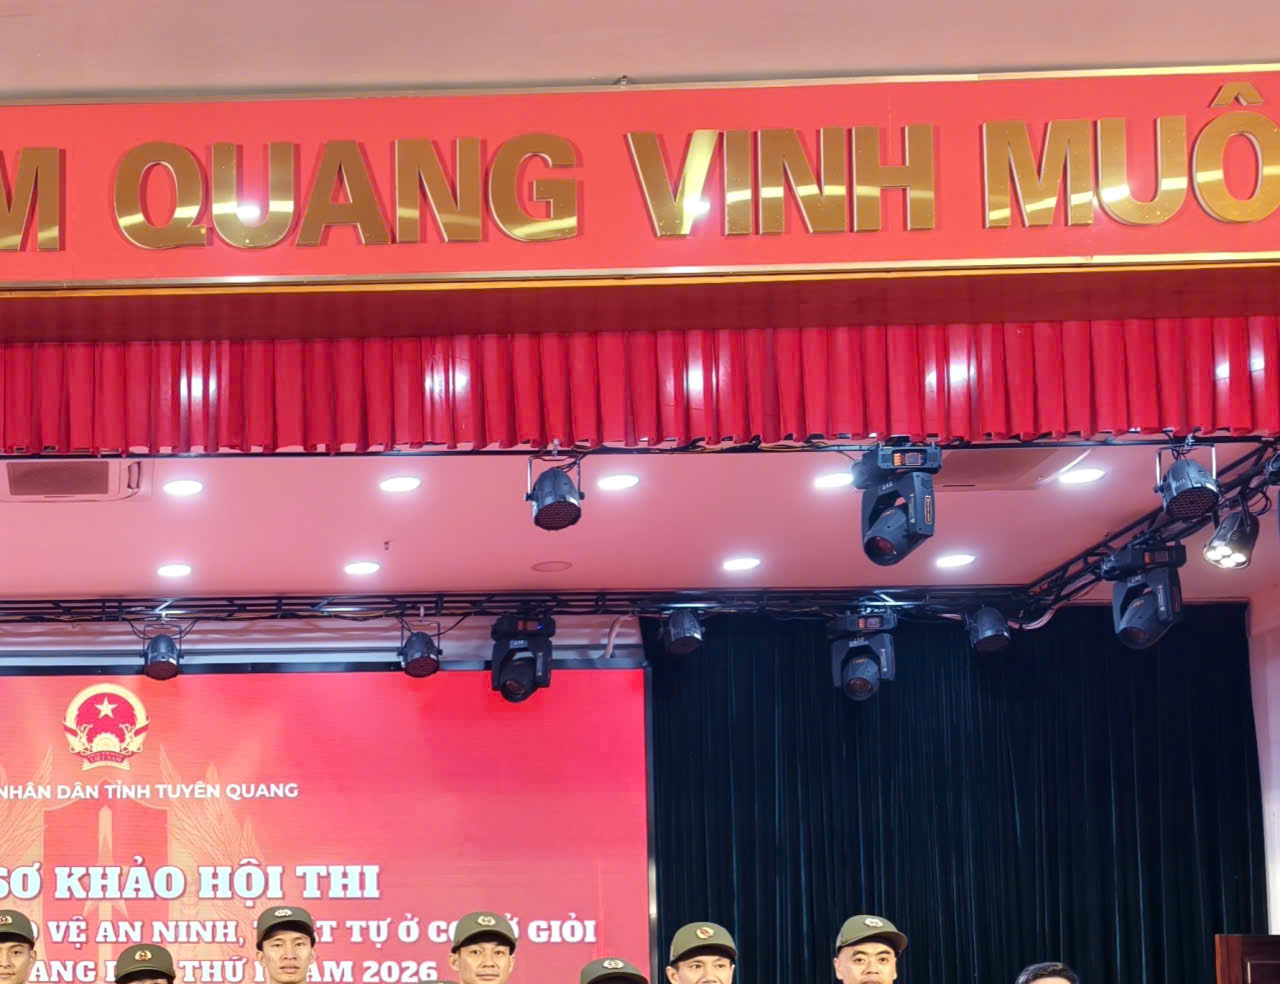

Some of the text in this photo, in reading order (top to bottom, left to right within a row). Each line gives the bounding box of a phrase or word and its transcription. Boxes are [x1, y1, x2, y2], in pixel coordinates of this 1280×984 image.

[114, 132, 580, 250] QUANG
[627, 124, 936, 237] VINH
[57, 781, 99, 799] DÂN
[104, 778, 150, 799] TỈNH
[155, 780, 220, 798] TUYÊN
[225, 782, 299, 800] QUANG
[54, 856, 186, 899] KHẢO
[198, 858, 286, 907] HỘI
[295, 865, 381, 899] THI
[47, 916, 87, 949] VỆ
[95, 921, 144, 943] AN
[160, 921, 245, 946] NINH,
[345, 917, 391, 948] TỰ
[398, 913, 419, 943] Ở
[528, 913, 596, 943] GIỎI
[179, 957, 247, 982] THỨ
[362, 961, 437, 983] 2026
